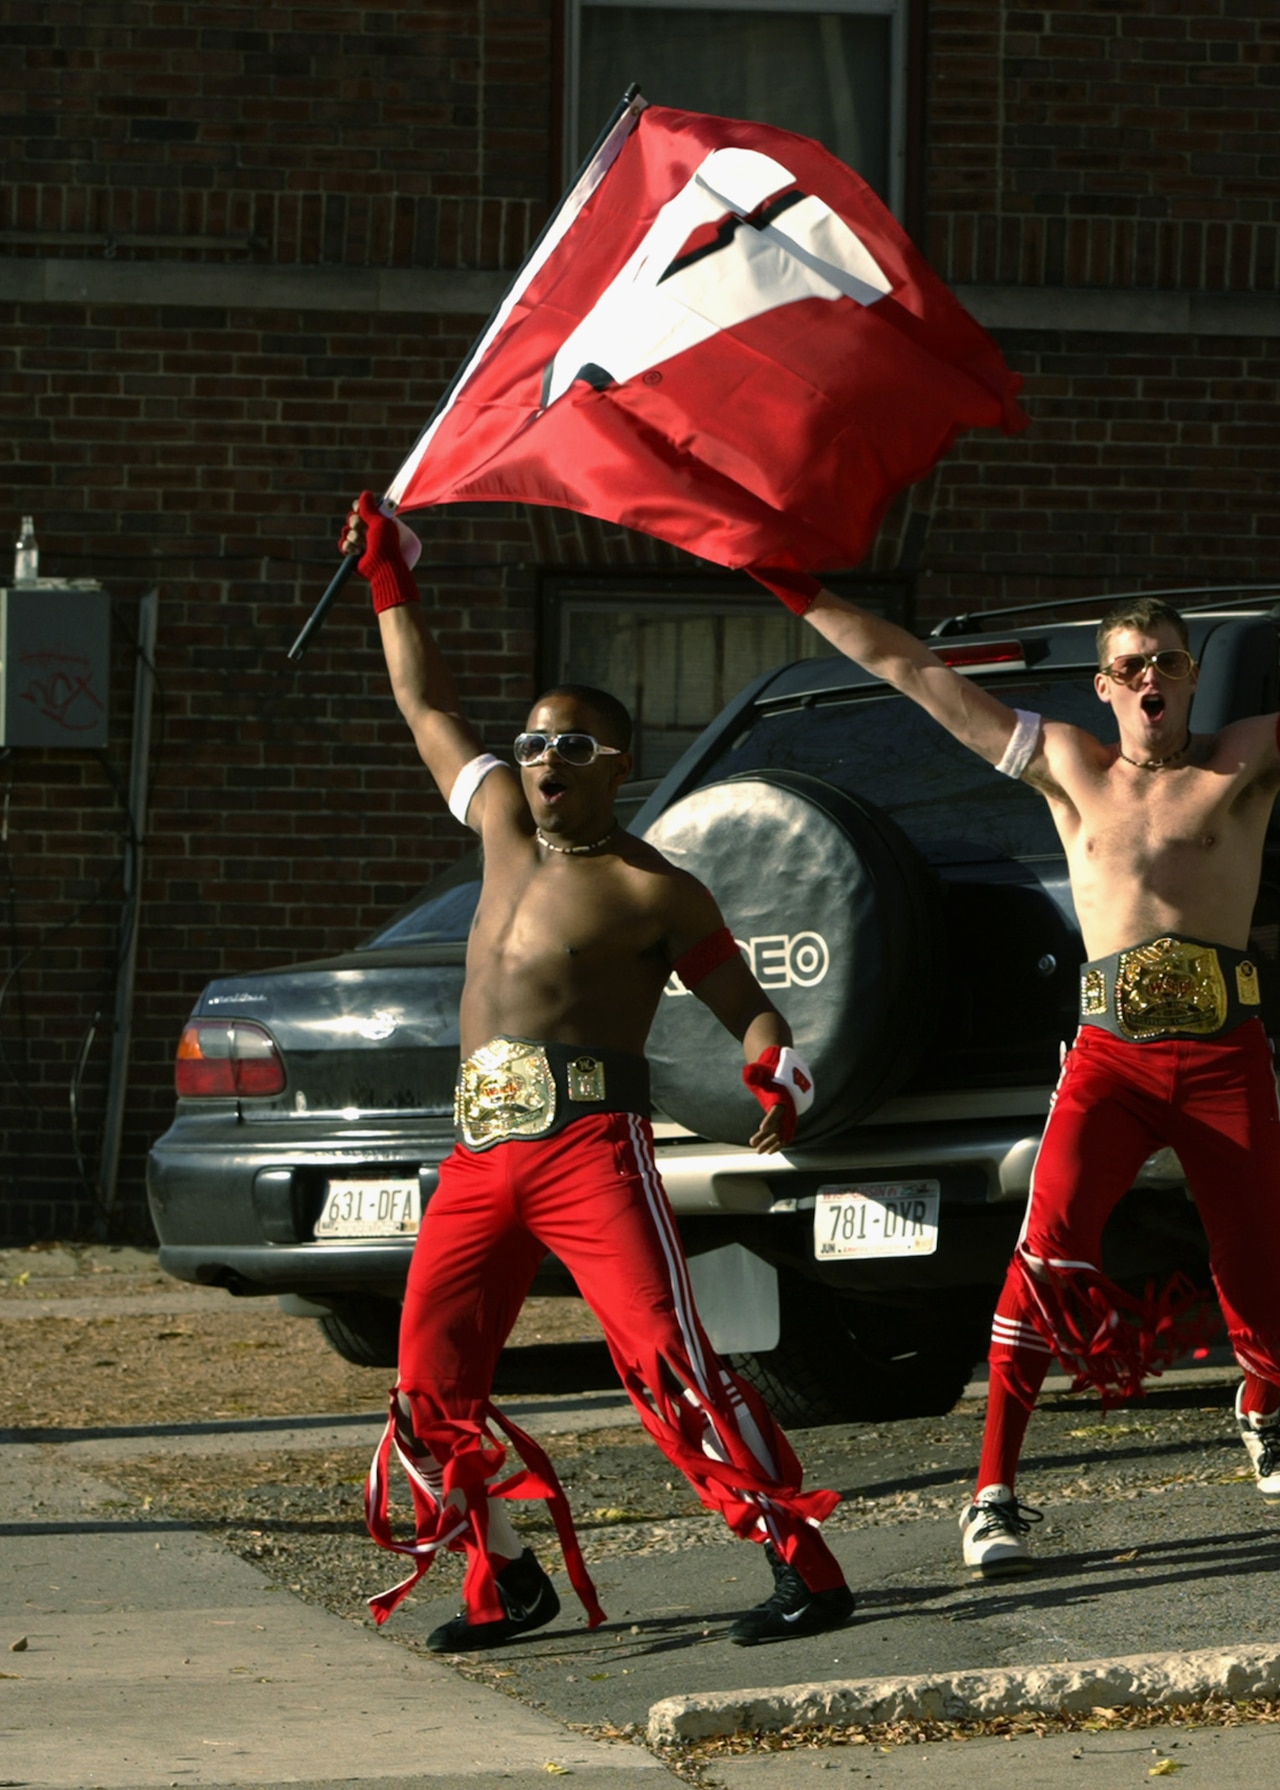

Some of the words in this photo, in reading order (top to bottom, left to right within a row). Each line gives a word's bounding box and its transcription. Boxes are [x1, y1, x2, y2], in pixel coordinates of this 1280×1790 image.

[328, 1189, 413, 1221] 631-DFA
[829, 1200, 926, 1241] 781-DYR
[820, 1244, 835, 1254] JUN
